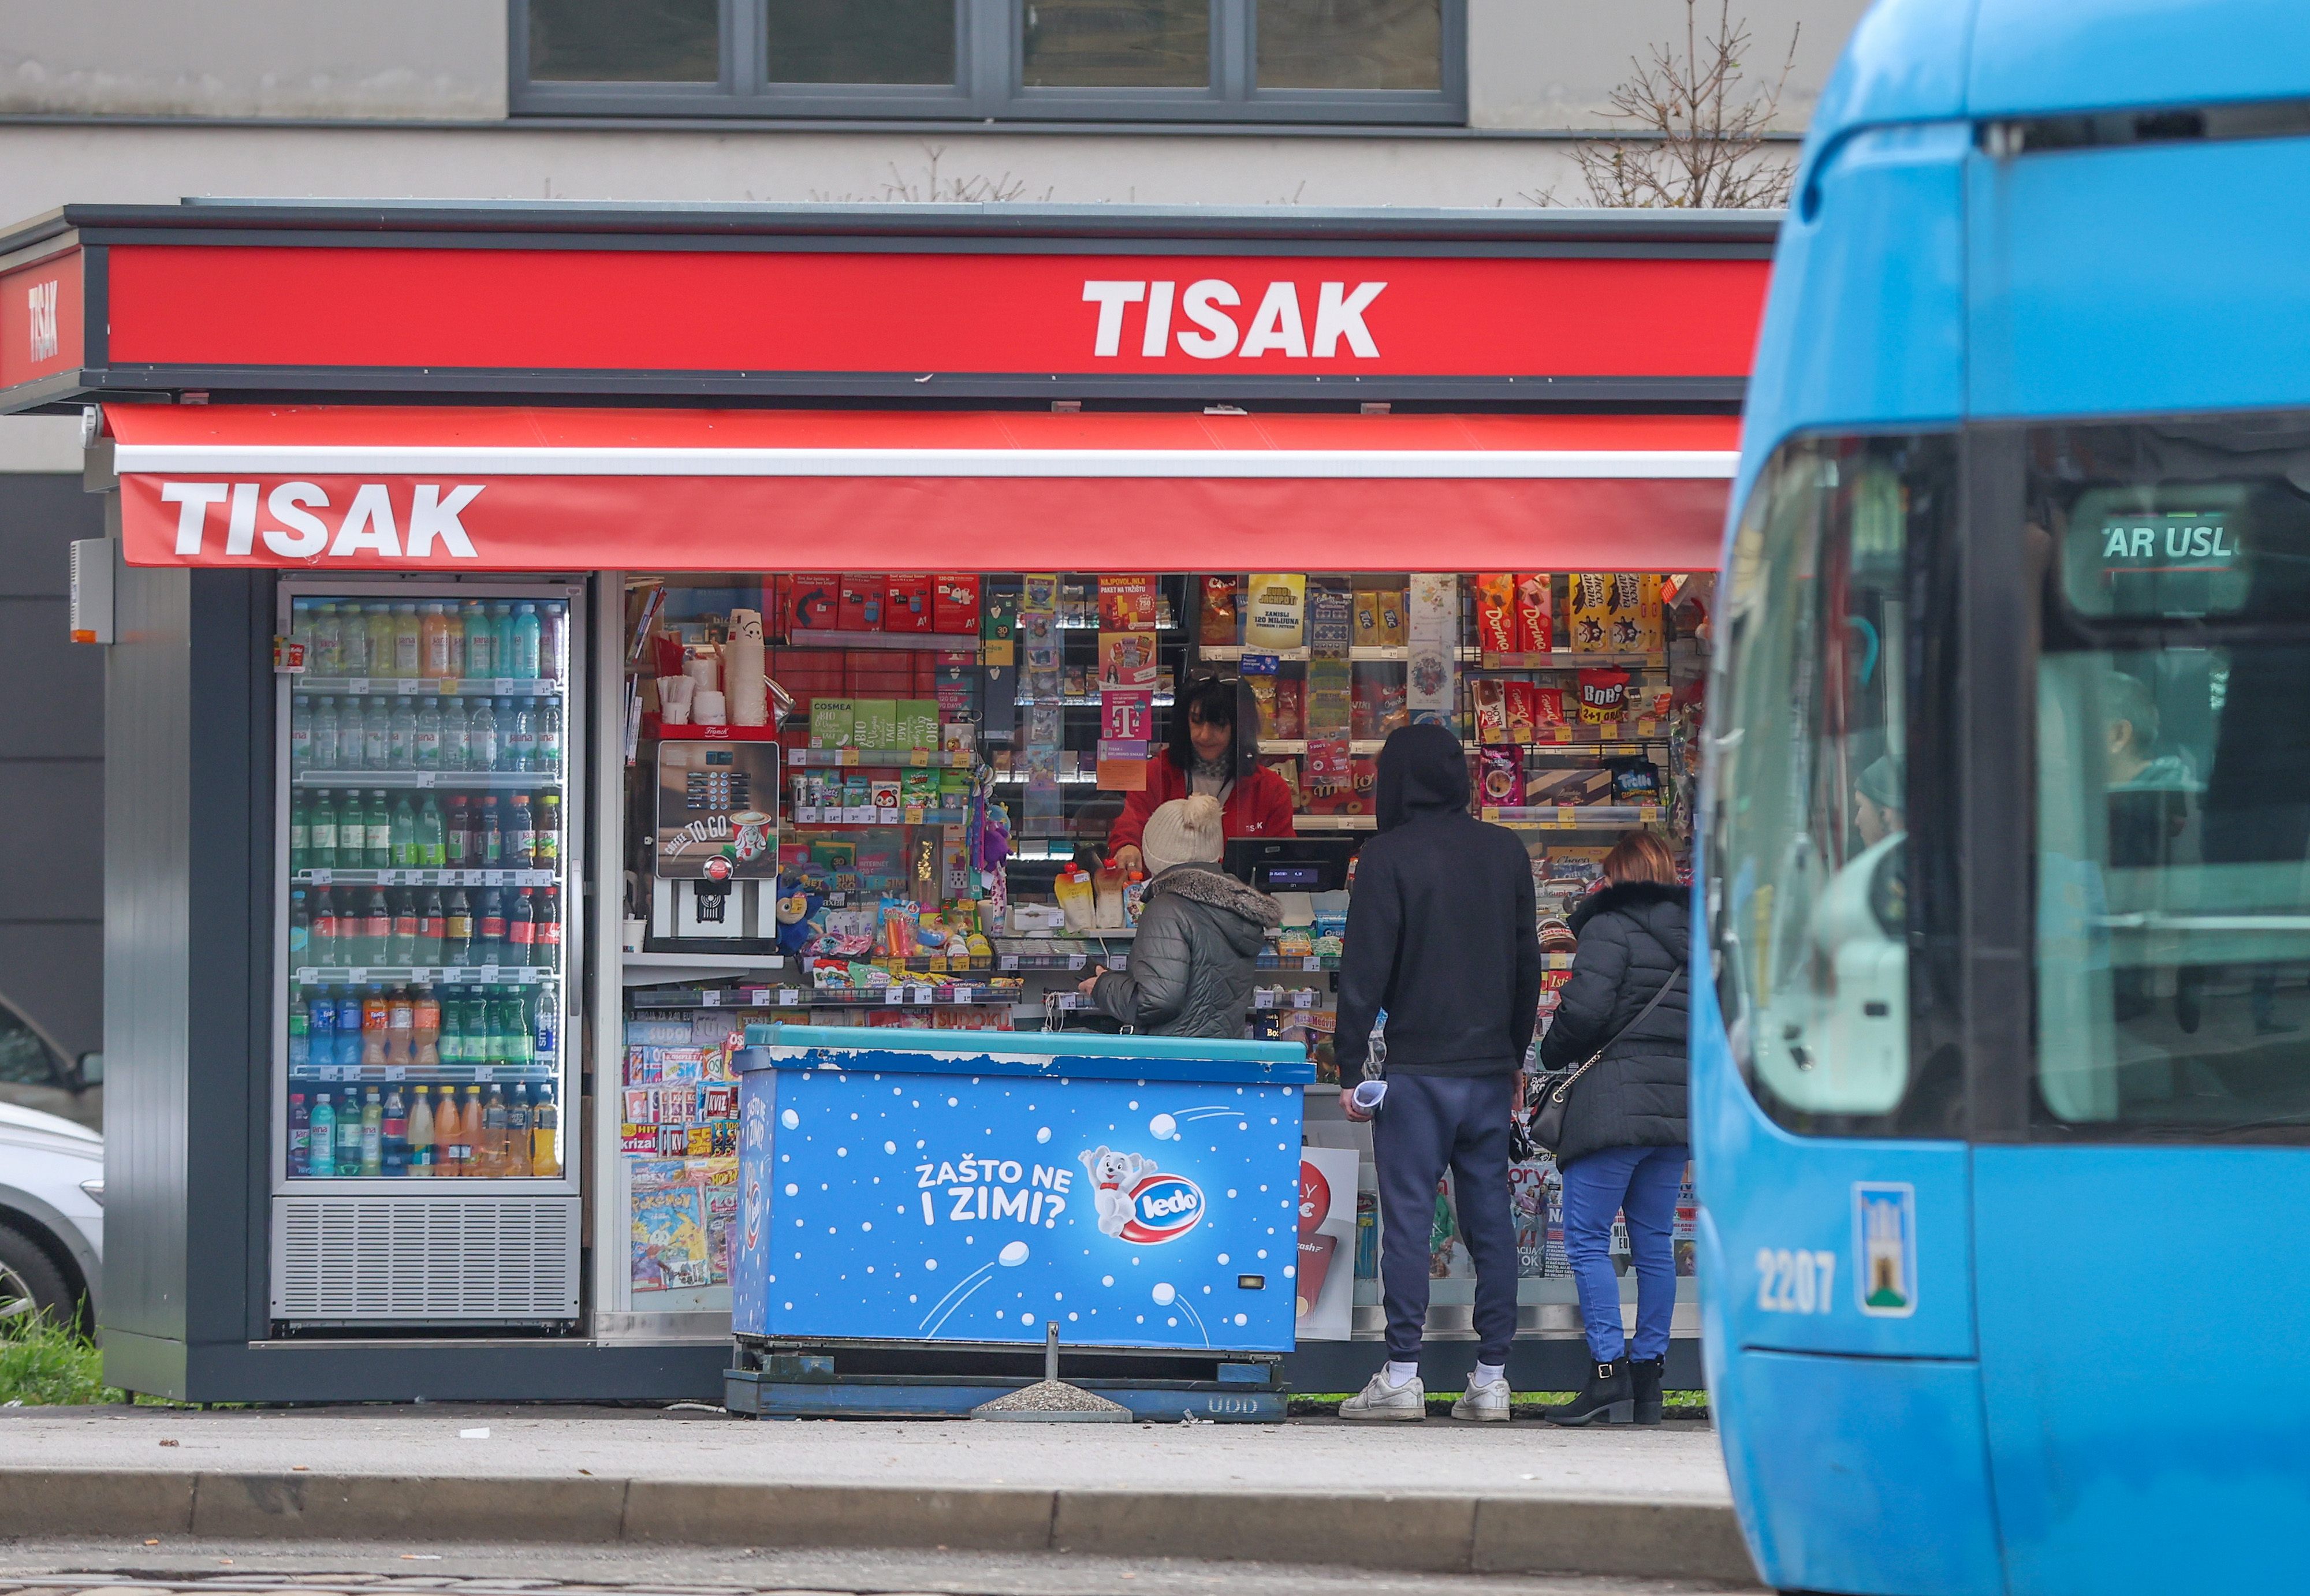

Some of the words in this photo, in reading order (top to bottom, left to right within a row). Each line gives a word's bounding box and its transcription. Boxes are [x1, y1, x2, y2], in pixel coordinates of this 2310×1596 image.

[28, 279, 59, 363] TISAK
[1082, 278, 1388, 360] TISAK
[161, 482, 487, 558] TISAK
[2102, 527, 2155, 558] AR
[2166, 527, 2240, 558] USL
[1258, 595, 1299, 605] JACKPOT
[1359, 610, 1373, 629] TUC
[1385, 610, 1399, 629] TUC
[1485, 605, 1510, 652] Dorina
[1523, 605, 1547, 652] Dorina
[820, 711, 836, 720] BIO
[1584, 708, 1601, 722] 2+1
[705, 727, 729, 736] Franck
[855, 721, 866, 741] BIO
[926, 722, 938, 743] BIO
[1618, 773, 1652, 788] Trolli
[665, 832, 688, 855] COFFEE
[685, 820, 707, 844] TO
[707, 815, 727, 837] GO
[938, 1010, 1010, 1027] SUDOKU
[1531, 1076, 1549, 1087] Svet
[709, 1094, 728, 1112] KVIZ
[672, 1133, 683, 1150] KV
[915, 1153, 1023, 1188] ZAŠTO
[1032, 1164, 1074, 1194] NE
[1508, 1168, 1549, 1188] ory
[712, 1194, 737, 1209] LO
[922, 1191, 935, 1226] I
[948, 1185, 1067, 1229] ZIMI?
[1142, 1189, 1198, 1220] ledo
[1757, 1247, 1836, 1315] 2207
